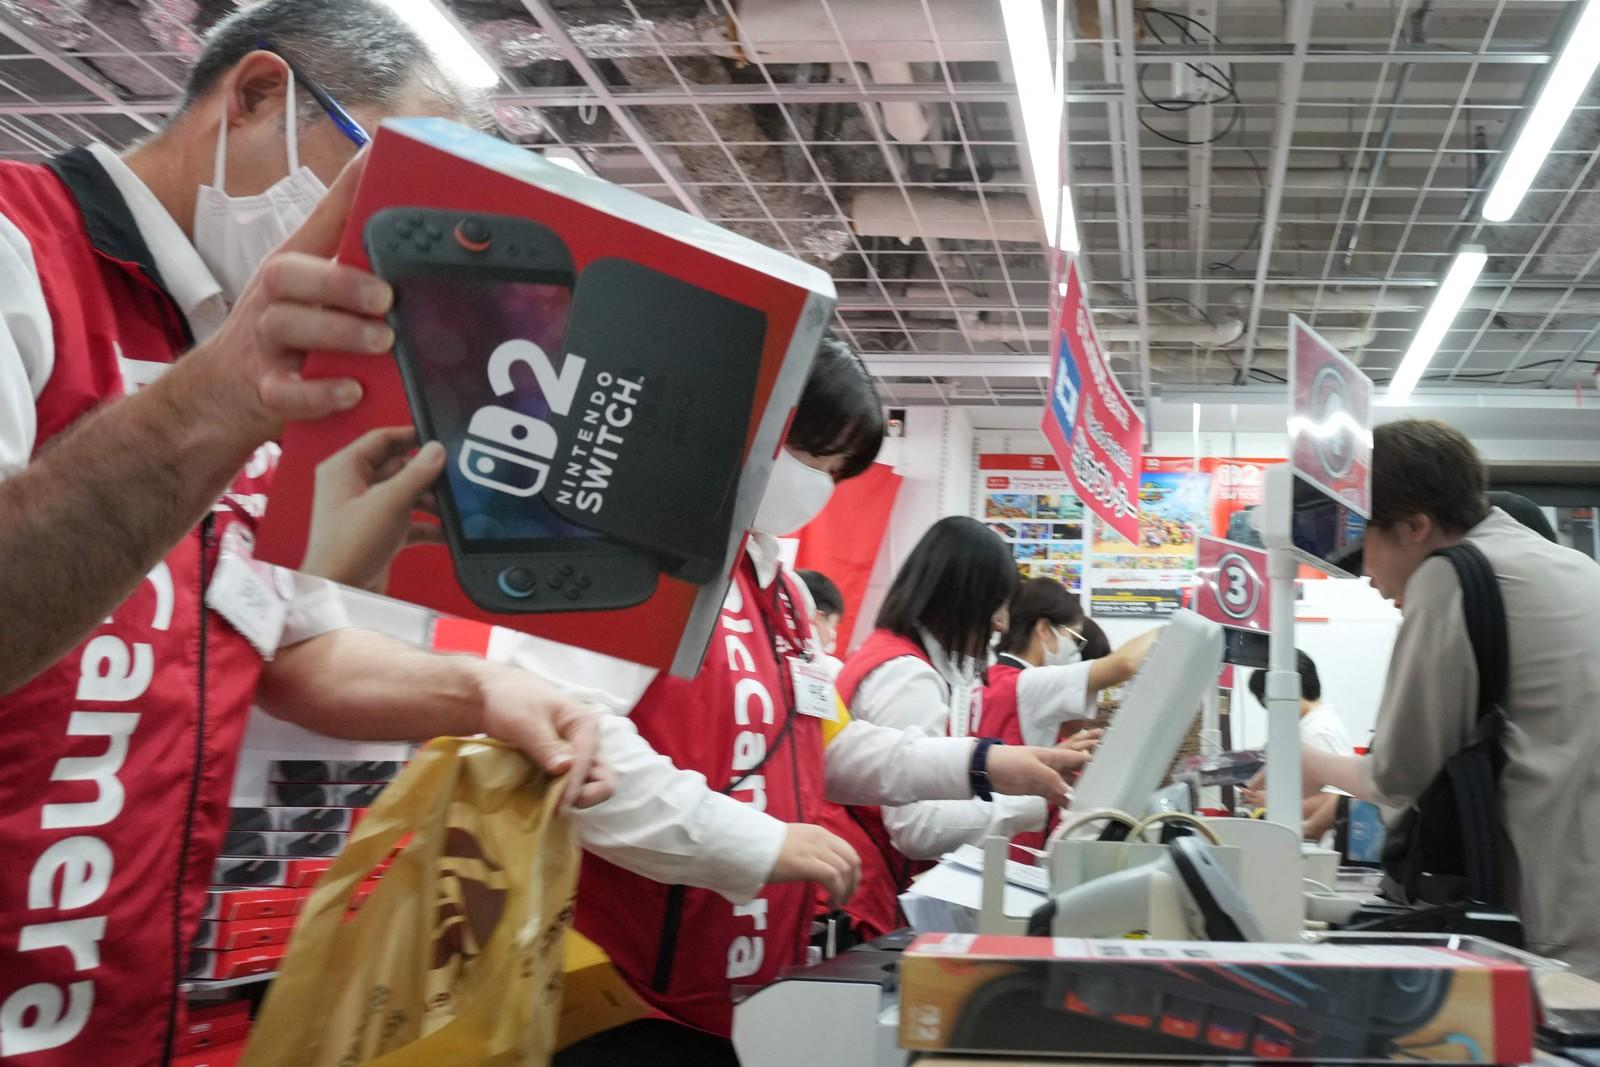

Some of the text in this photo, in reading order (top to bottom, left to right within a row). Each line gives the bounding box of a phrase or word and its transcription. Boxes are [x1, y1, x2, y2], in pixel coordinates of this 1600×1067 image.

[555, 371, 613, 505] NINTENDO
[575, 377, 643, 514] SWITCH
[1224, 565, 1249, 606] 3
